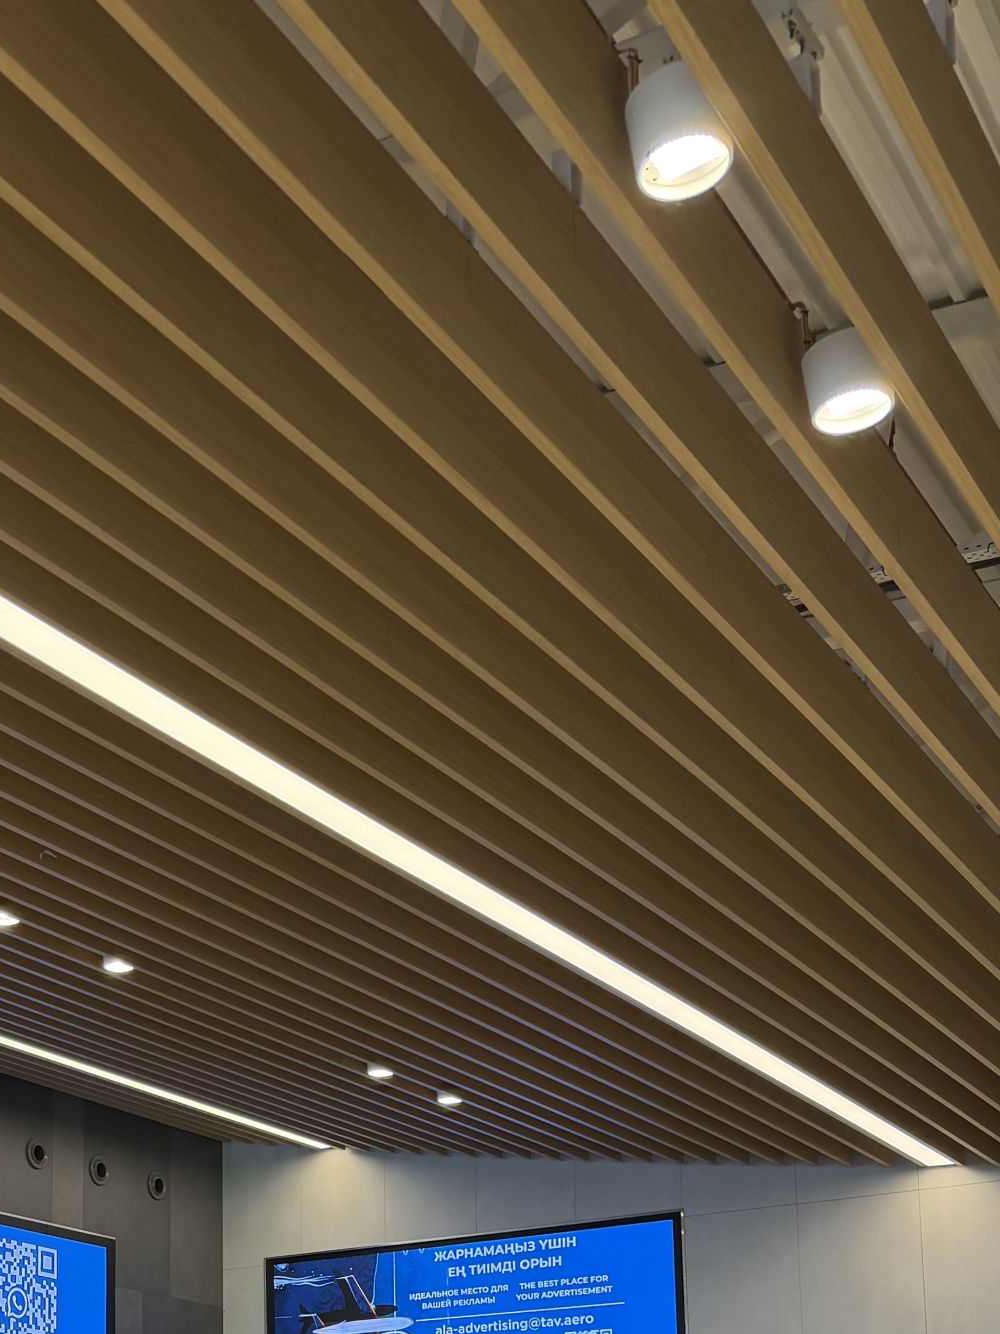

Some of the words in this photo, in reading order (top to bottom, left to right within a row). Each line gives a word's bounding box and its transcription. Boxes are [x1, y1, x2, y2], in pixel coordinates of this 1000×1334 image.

[434, 1241, 535, 1262] ЖАРНАМАҢЫЗ
[539, 1236, 576, 1250] ҮШІН
[448, 1266, 466, 1278] ЕҢ
[469, 1261, 516, 1275] ТИІМДІ
[520, 1256, 562, 1269] ОРЫН
[538, 1280, 559, 1288] BEST
[561, 1277, 588, 1286] PLACE
[590, 1275, 608, 1283] FOR
[409, 1289, 459, 1301] ИДЕАЛЬНОЕ
[461, 1286, 489, 1295] МЕСТО
[490, 1284, 508, 1293] ДЛЯ
[516, 1292, 539, 1300] YOUR
[541, 1285, 613, 1298] ADVERTISEMENT
[422, 1299, 451, 1309] ВАШЕЙ
[453, 1296, 495, 1306] РЕКЛАМЫ
